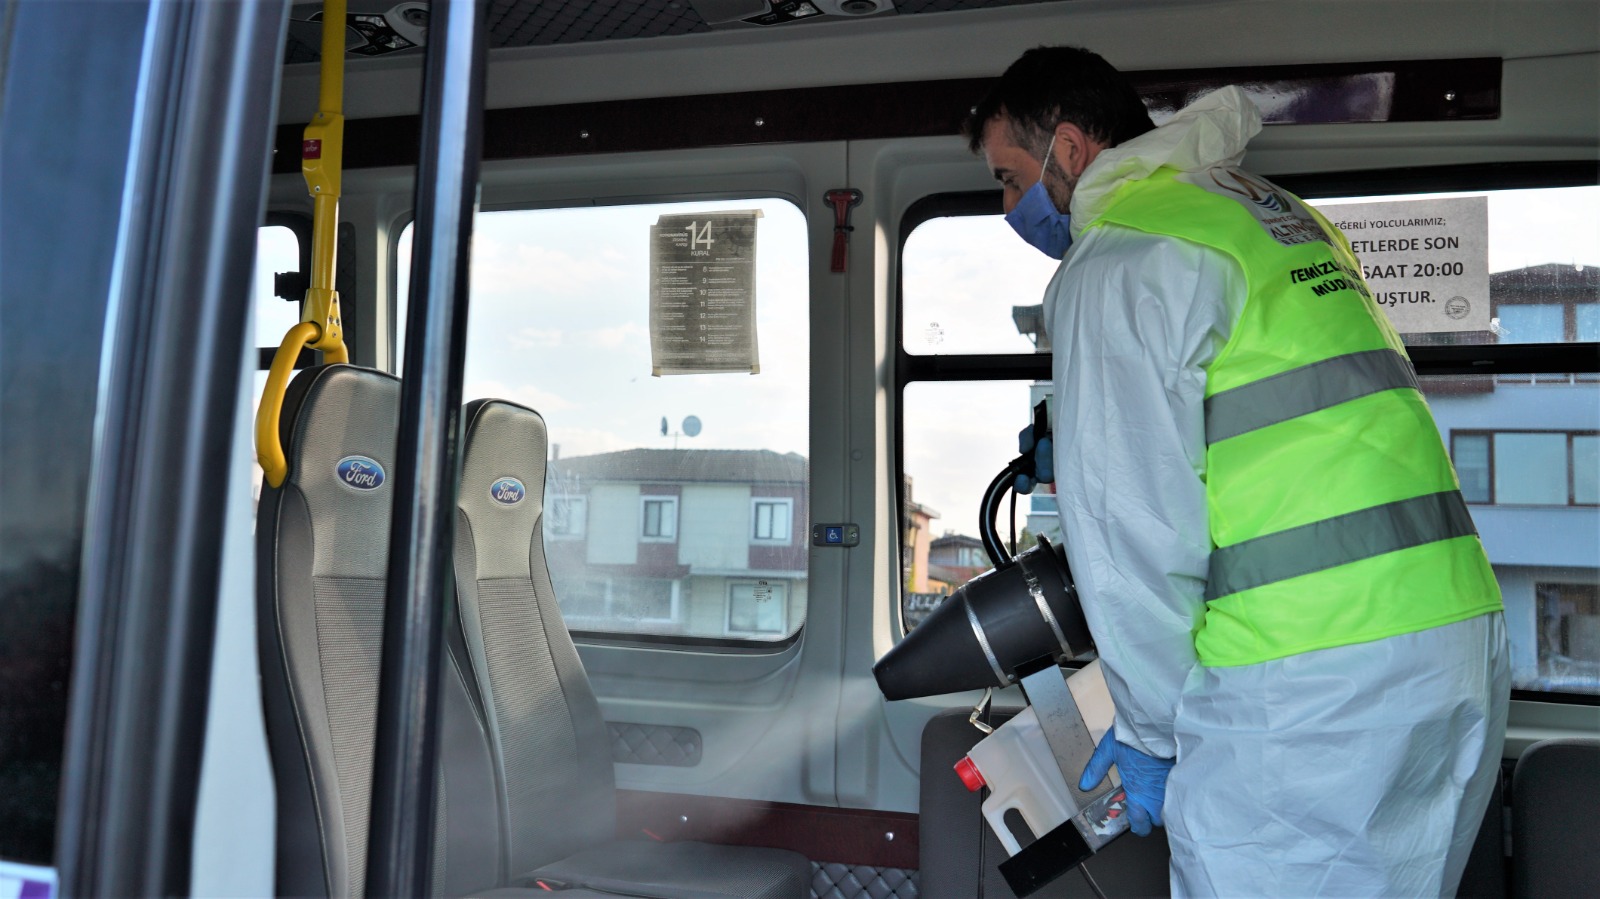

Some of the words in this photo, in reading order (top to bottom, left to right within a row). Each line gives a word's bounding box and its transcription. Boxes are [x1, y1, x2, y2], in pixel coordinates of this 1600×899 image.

[1332, 219, 1367, 230] EĞERLİ
[1369, 217, 1447, 229] YOLCULARIMIZ;
[685, 220, 715, 250] 14
[1351, 238, 1419, 254] ETLERDE
[1424, 236, 1460, 250] SON
[1290, 260, 1345, 284] TEMİZL
[1363, 264, 1408, 280] SAAT
[1413, 261, 1464, 279] 20:00
[1373, 290, 1437, 308] UŞTUR.
[345, 461, 378, 487] Ford
[497, 481, 520, 502] Ford
